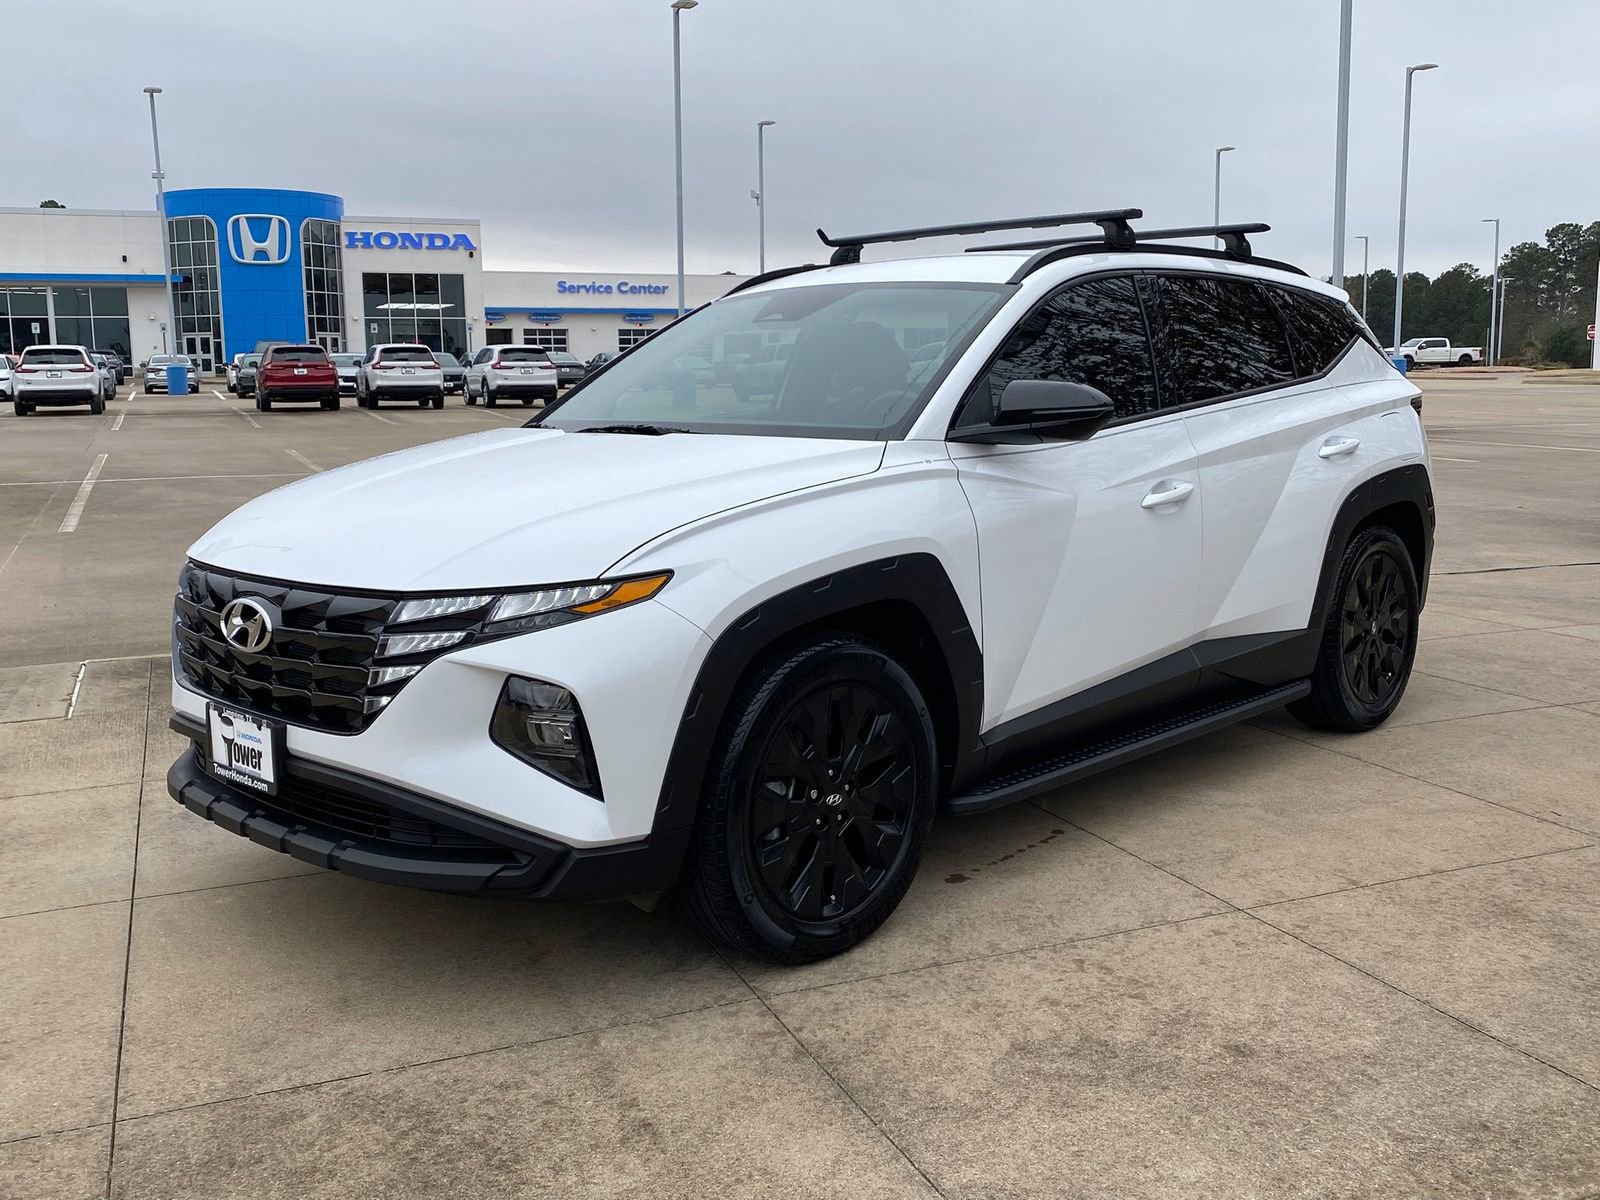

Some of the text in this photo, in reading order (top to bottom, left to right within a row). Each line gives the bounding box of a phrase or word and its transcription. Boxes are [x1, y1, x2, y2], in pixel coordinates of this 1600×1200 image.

[344, 231, 477, 251] HONDA
[557, 280, 669, 295] Service Center
[241, 732, 263, 745] HONDA
[221, 734, 263, 771] Tower
[213, 762, 268, 792] TowerHonda.com
